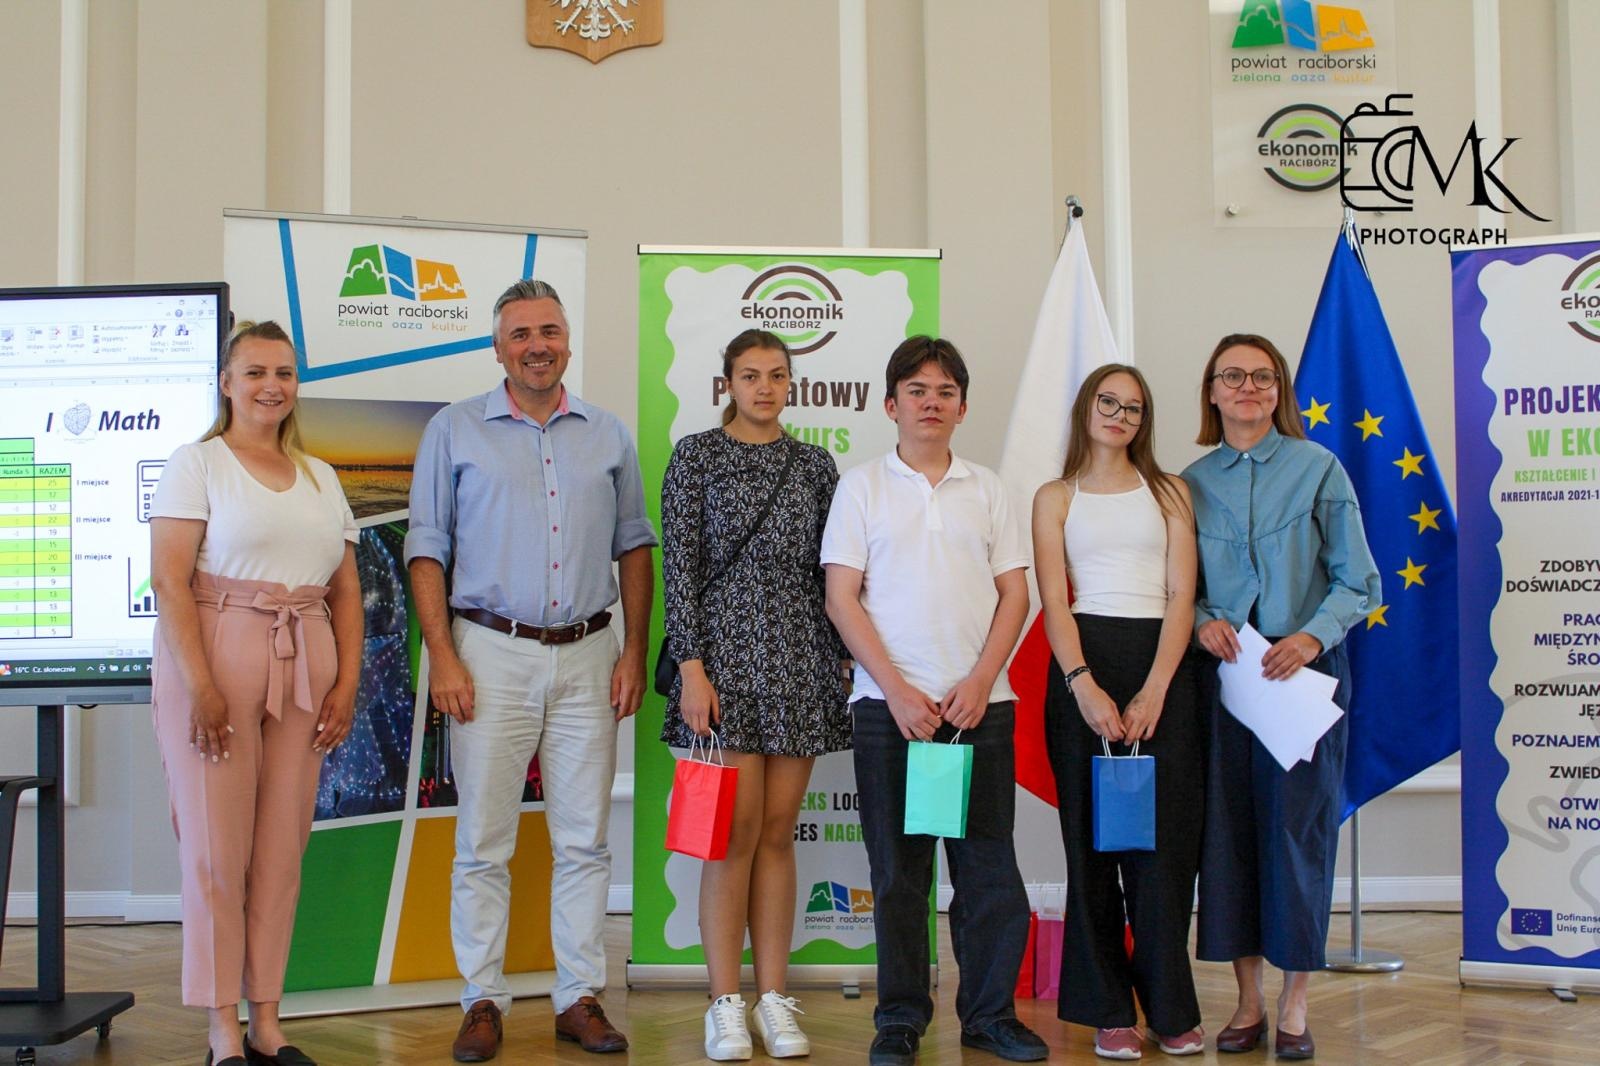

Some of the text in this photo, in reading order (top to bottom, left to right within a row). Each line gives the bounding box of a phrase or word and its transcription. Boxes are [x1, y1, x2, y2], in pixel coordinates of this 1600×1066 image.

[1232, 54, 1376, 72] powiat raciborski
[1232, 72, 1281, 82] zielona
[1291, 74, 1326, 82] oaza
[1258, 140, 1358, 156] ekonomk
[1280, 158, 1336, 167] RACIBÓRZ
[338, 302, 468, 319] powiat raciborski
[741, 302, 843, 320] ekonomik
[338, 318, 467, 332] zielona oaza kultur
[762, 320, 822, 329] RACIBÓRZ
[712, 376, 869, 412] Patowy
[1504, 384, 1600, 415] PROJEK
[46, 409, 161, 433] I Math
[1527, 429, 1550, 457] W
[39, 467, 67, 475] RAZEM
[1514, 468, 1588, 482] KSZTAŁCENIE
[81, 480, 109, 488] miejsce
[1501, 490, 1565, 502] AKREDYTACJA
[82, 516, 111, 524] miejsce
[84, 553, 112, 562] miejsce
[1540, 560, 1600, 572] ZDOBY
[1548, 816, 1572, 829] NA
[804, 914, 834, 924] powiat
[1556, 913, 1600, 922] Dofinans
[1556, 924, 1578, 934] Unię
